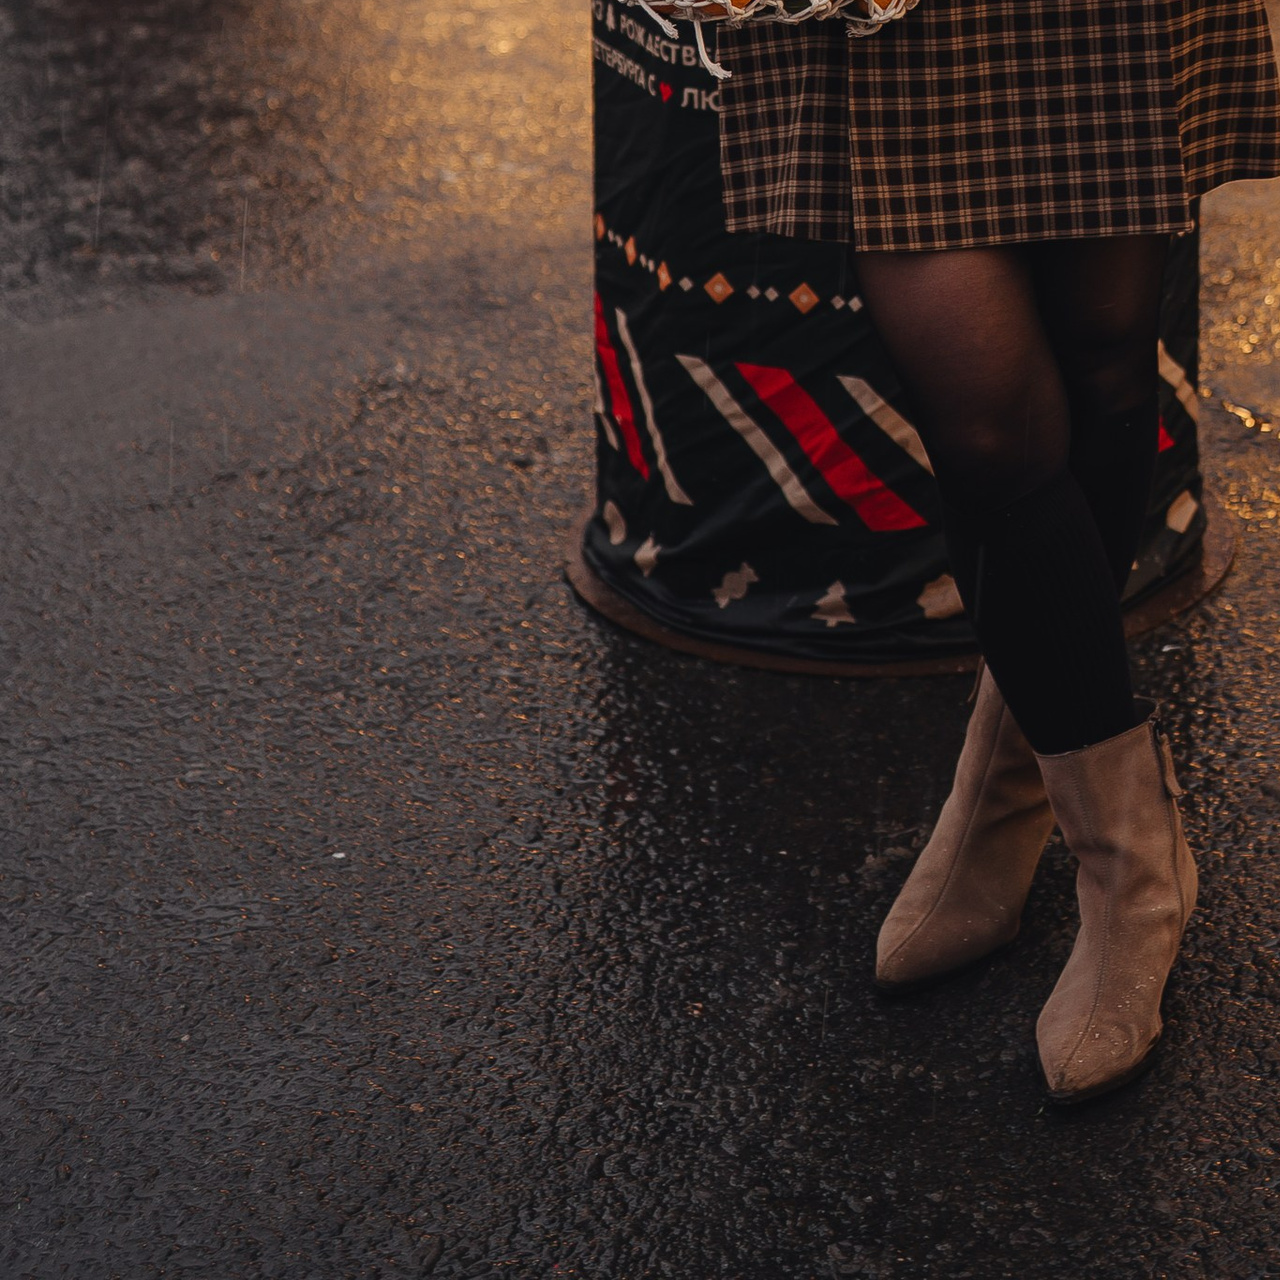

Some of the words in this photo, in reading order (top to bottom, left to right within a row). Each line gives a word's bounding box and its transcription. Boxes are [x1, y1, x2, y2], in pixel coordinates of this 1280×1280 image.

[593, 36, 647, 90] ЕТЕРБУРГА
[647, 73, 657, 97] С
[620, 13, 719, 68] РОЖДЕСТВ
